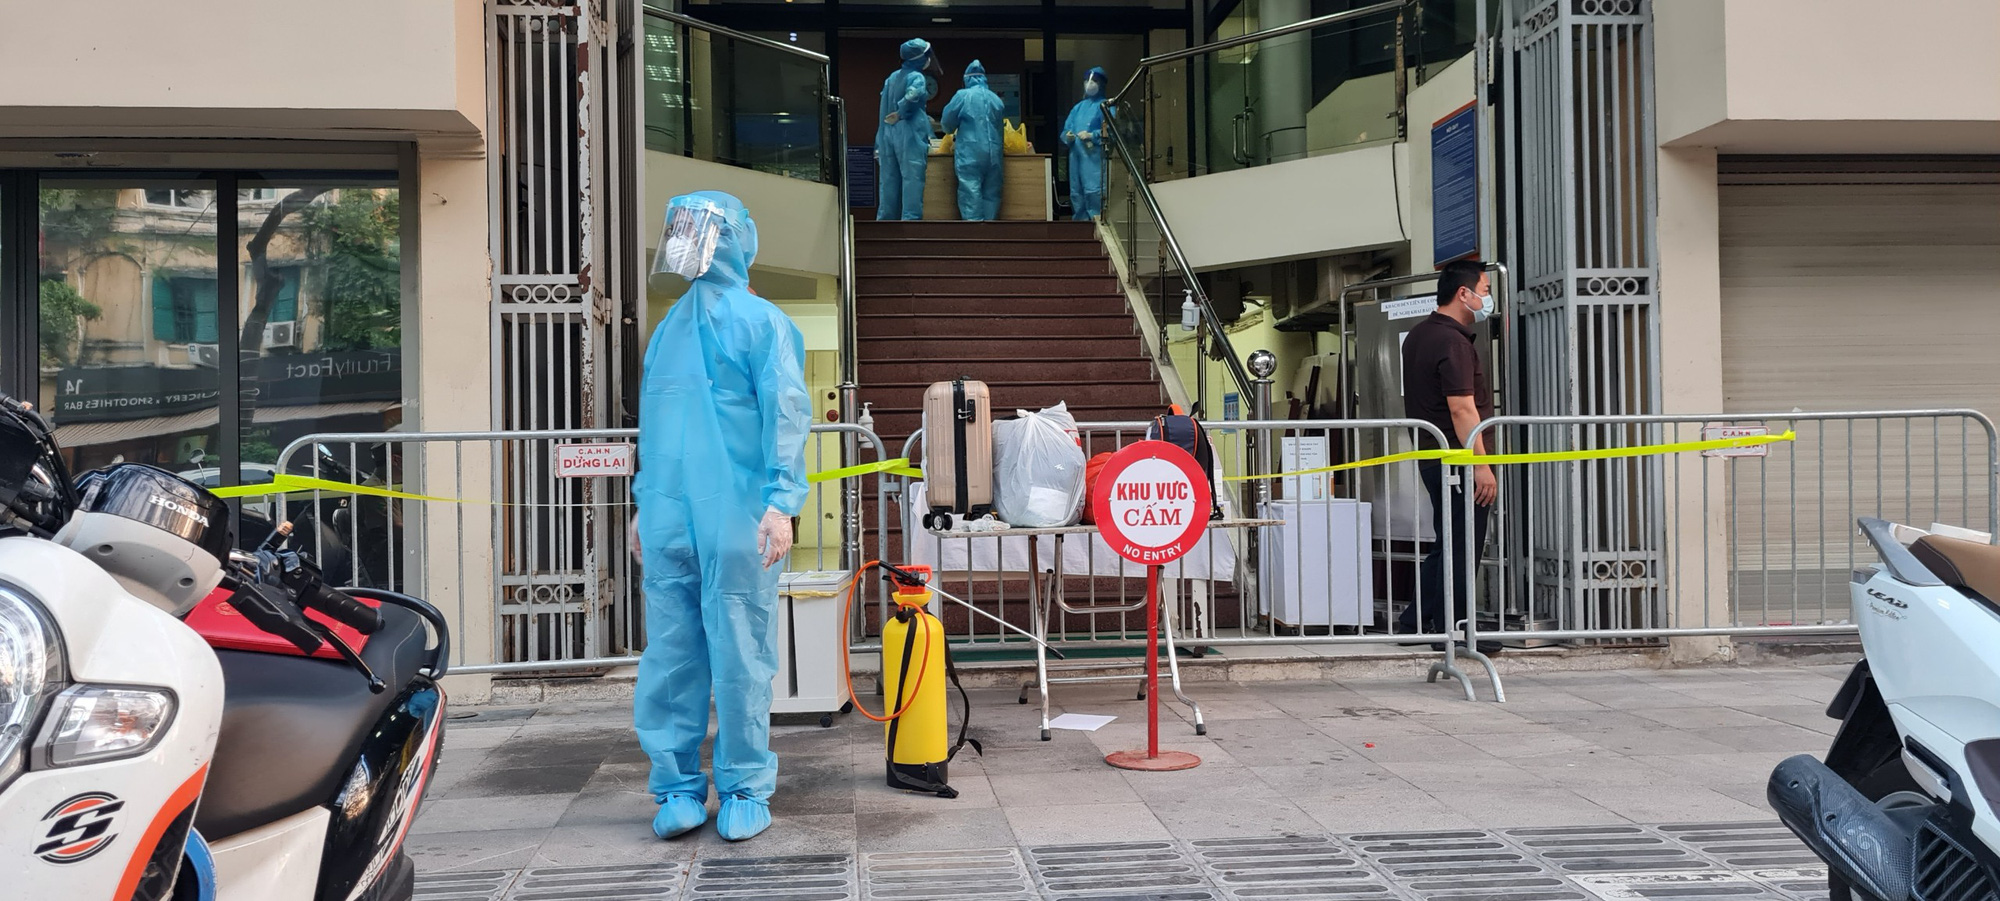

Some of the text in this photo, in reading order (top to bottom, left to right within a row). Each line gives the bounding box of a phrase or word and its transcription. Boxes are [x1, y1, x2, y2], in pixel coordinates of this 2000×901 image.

[563, 455, 626, 470] DỪNG LẠI
[1117, 480, 1188, 505] KHU VỰC
[148, 494, 210, 528] HONDA
[1123, 501, 1182, 527] CẤM
[1123, 542, 1182, 560] NO ENTRY
[1866, 588, 1909, 609] LEAD
